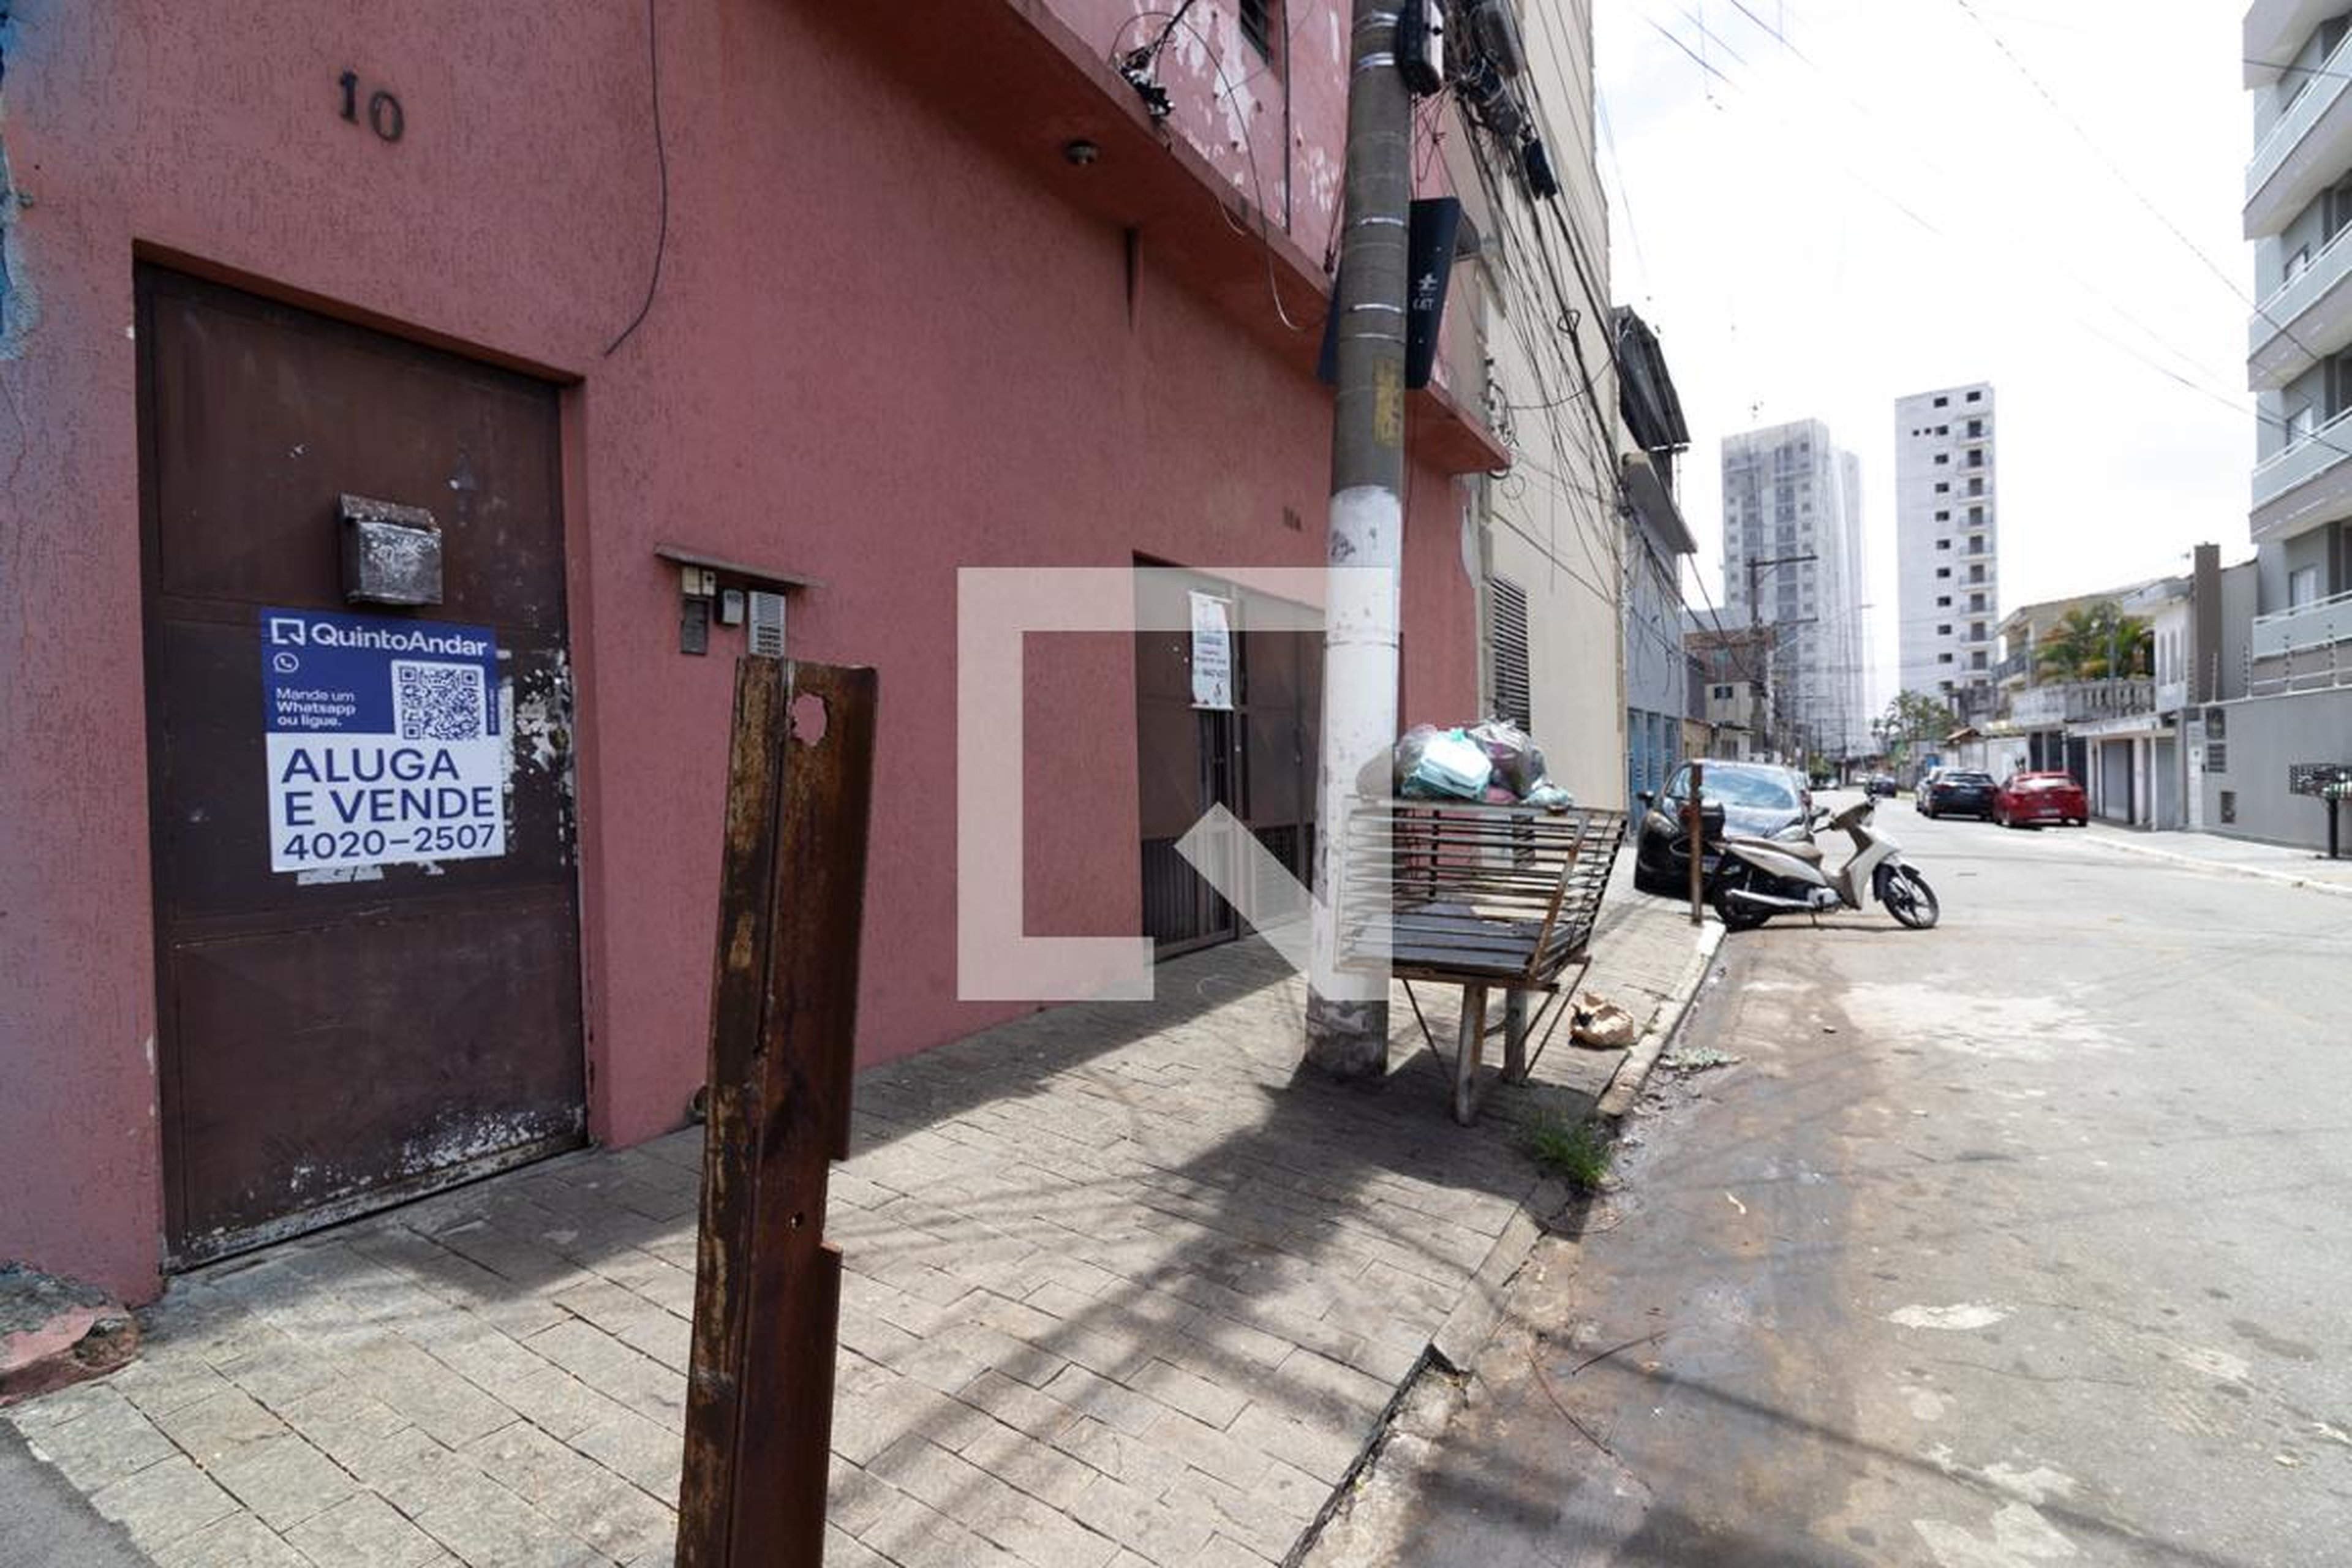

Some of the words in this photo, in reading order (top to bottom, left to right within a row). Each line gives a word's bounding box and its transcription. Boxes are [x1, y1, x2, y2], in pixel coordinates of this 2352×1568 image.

[339, 70, 405, 143] 10
[311, 622, 488, 657] QuintoAndar
[276, 687, 329, 701] Mande
[331, 692, 355, 703] um
[276, 701, 356, 717] Whatsapp
[277, 715, 298, 726] ou
[301, 714, 342, 729] ligue.
[281, 748, 459, 784] ALUGA
[284, 791, 315, 826] E
[329, 786, 495, 824] VENDE
[283, 824, 495, 860] 4020-2507
